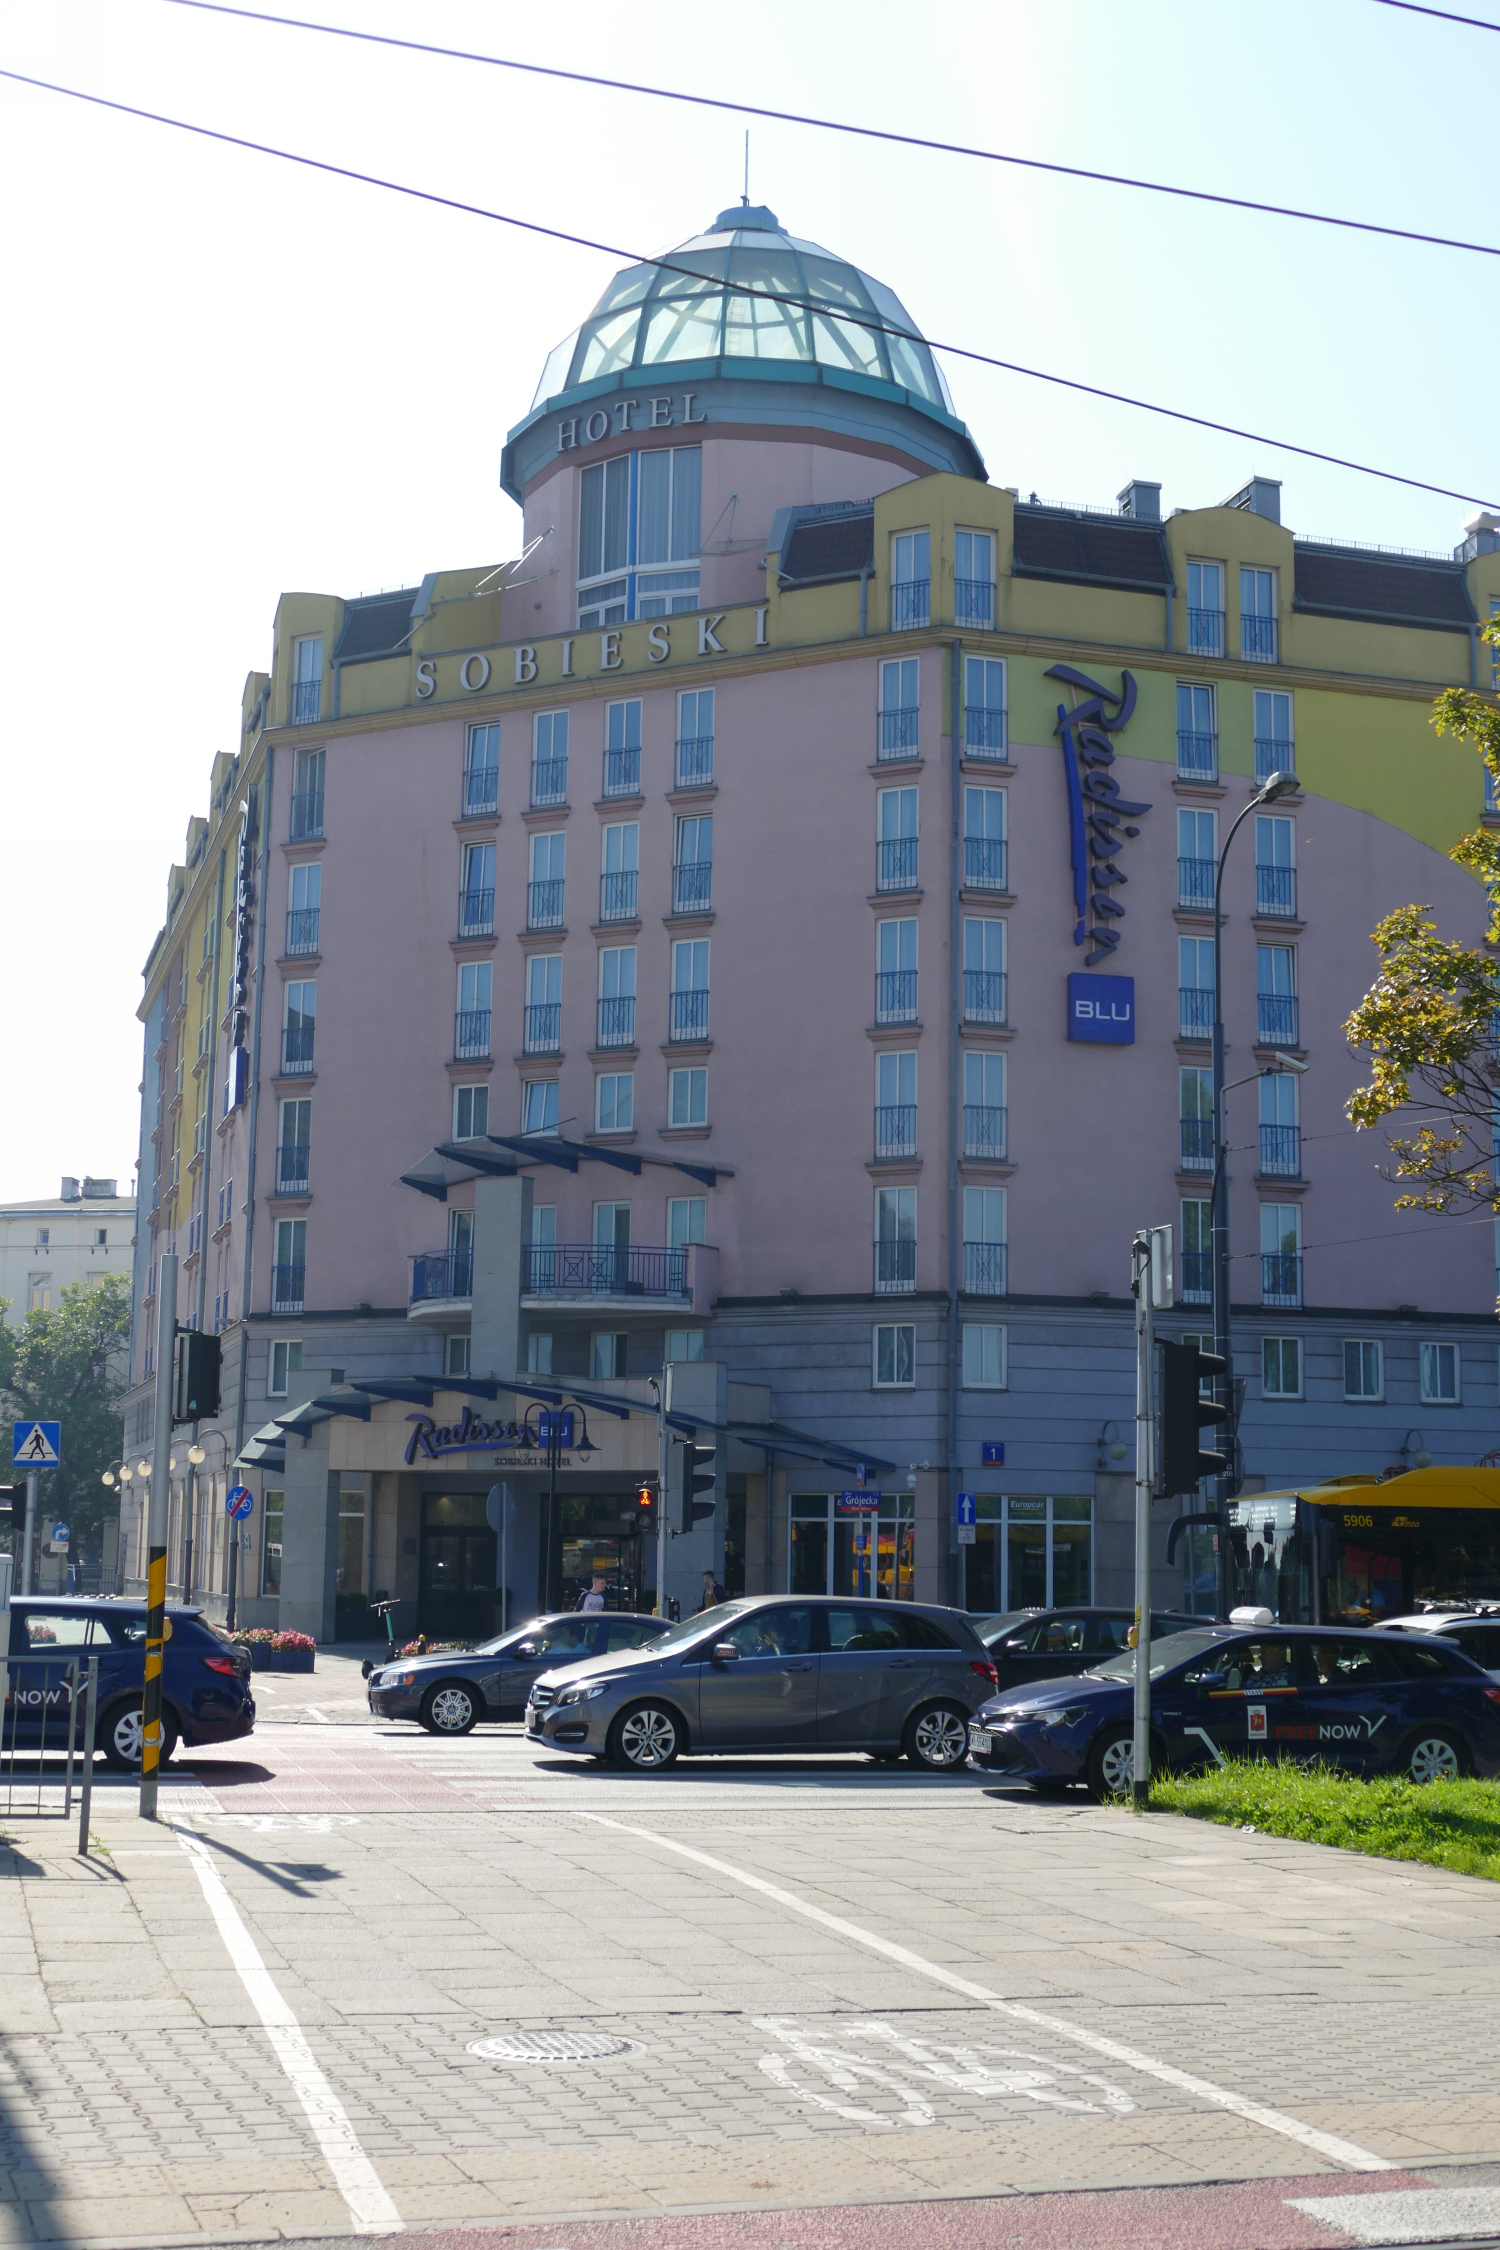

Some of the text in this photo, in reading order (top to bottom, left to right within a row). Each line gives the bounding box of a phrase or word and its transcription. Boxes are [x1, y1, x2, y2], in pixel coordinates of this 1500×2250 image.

[556, 393, 707, 454] HOTEL
[415, 607, 770, 699] SOBIESKI
[1043, 663, 1154, 968] Radisson
[1075, 1000, 1130, 1021] BLU
[404, 1405, 540, 1465] Radisson
[990, 1447, 996, 1460] 1
[845, 1495, 878, 1507] Grójecka
[1010, 1500, 1044, 1510] Europcar
[1343, 1514, 1373, 1528] 5906
